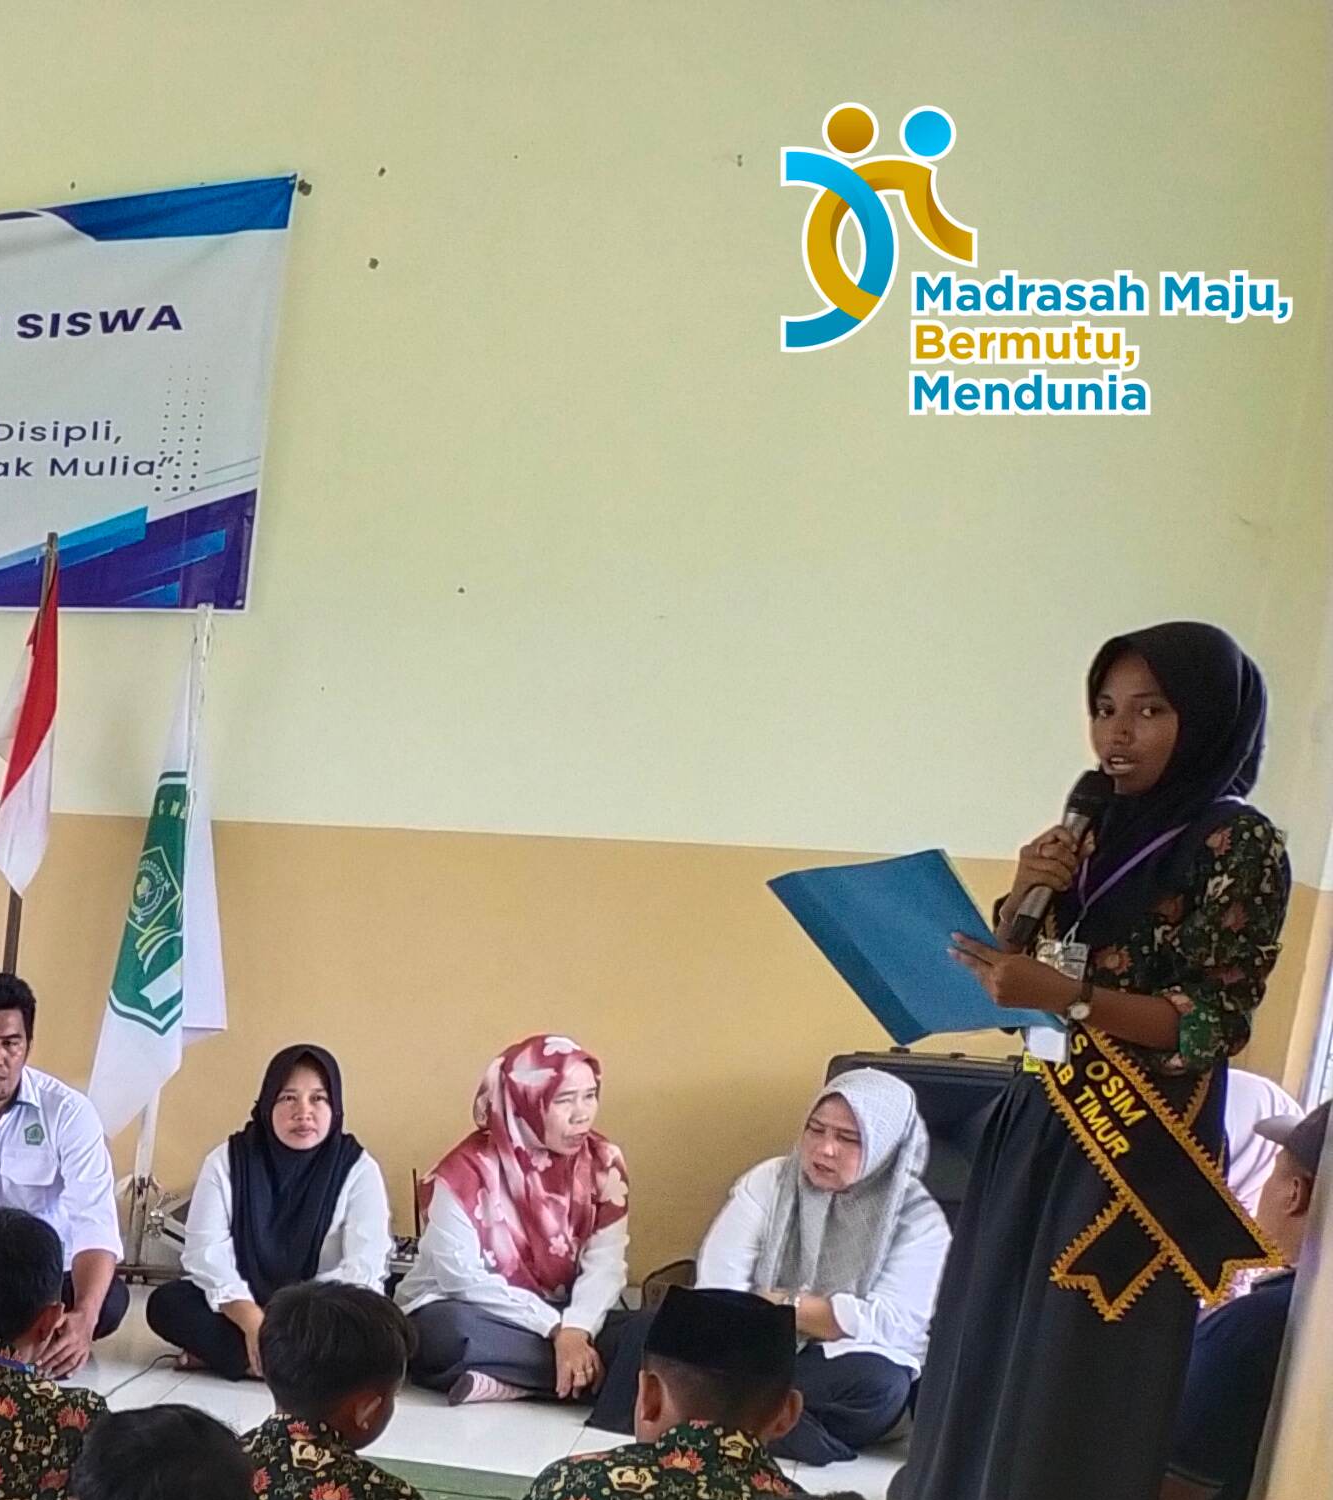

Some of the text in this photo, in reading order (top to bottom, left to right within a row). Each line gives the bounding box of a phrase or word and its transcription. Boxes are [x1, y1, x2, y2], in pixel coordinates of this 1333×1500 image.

[16, 305, 183, 340] SISWA
[1074, 1085, 1132, 1159] TIMUR
[1085, 1060, 1147, 1127] OSIM
